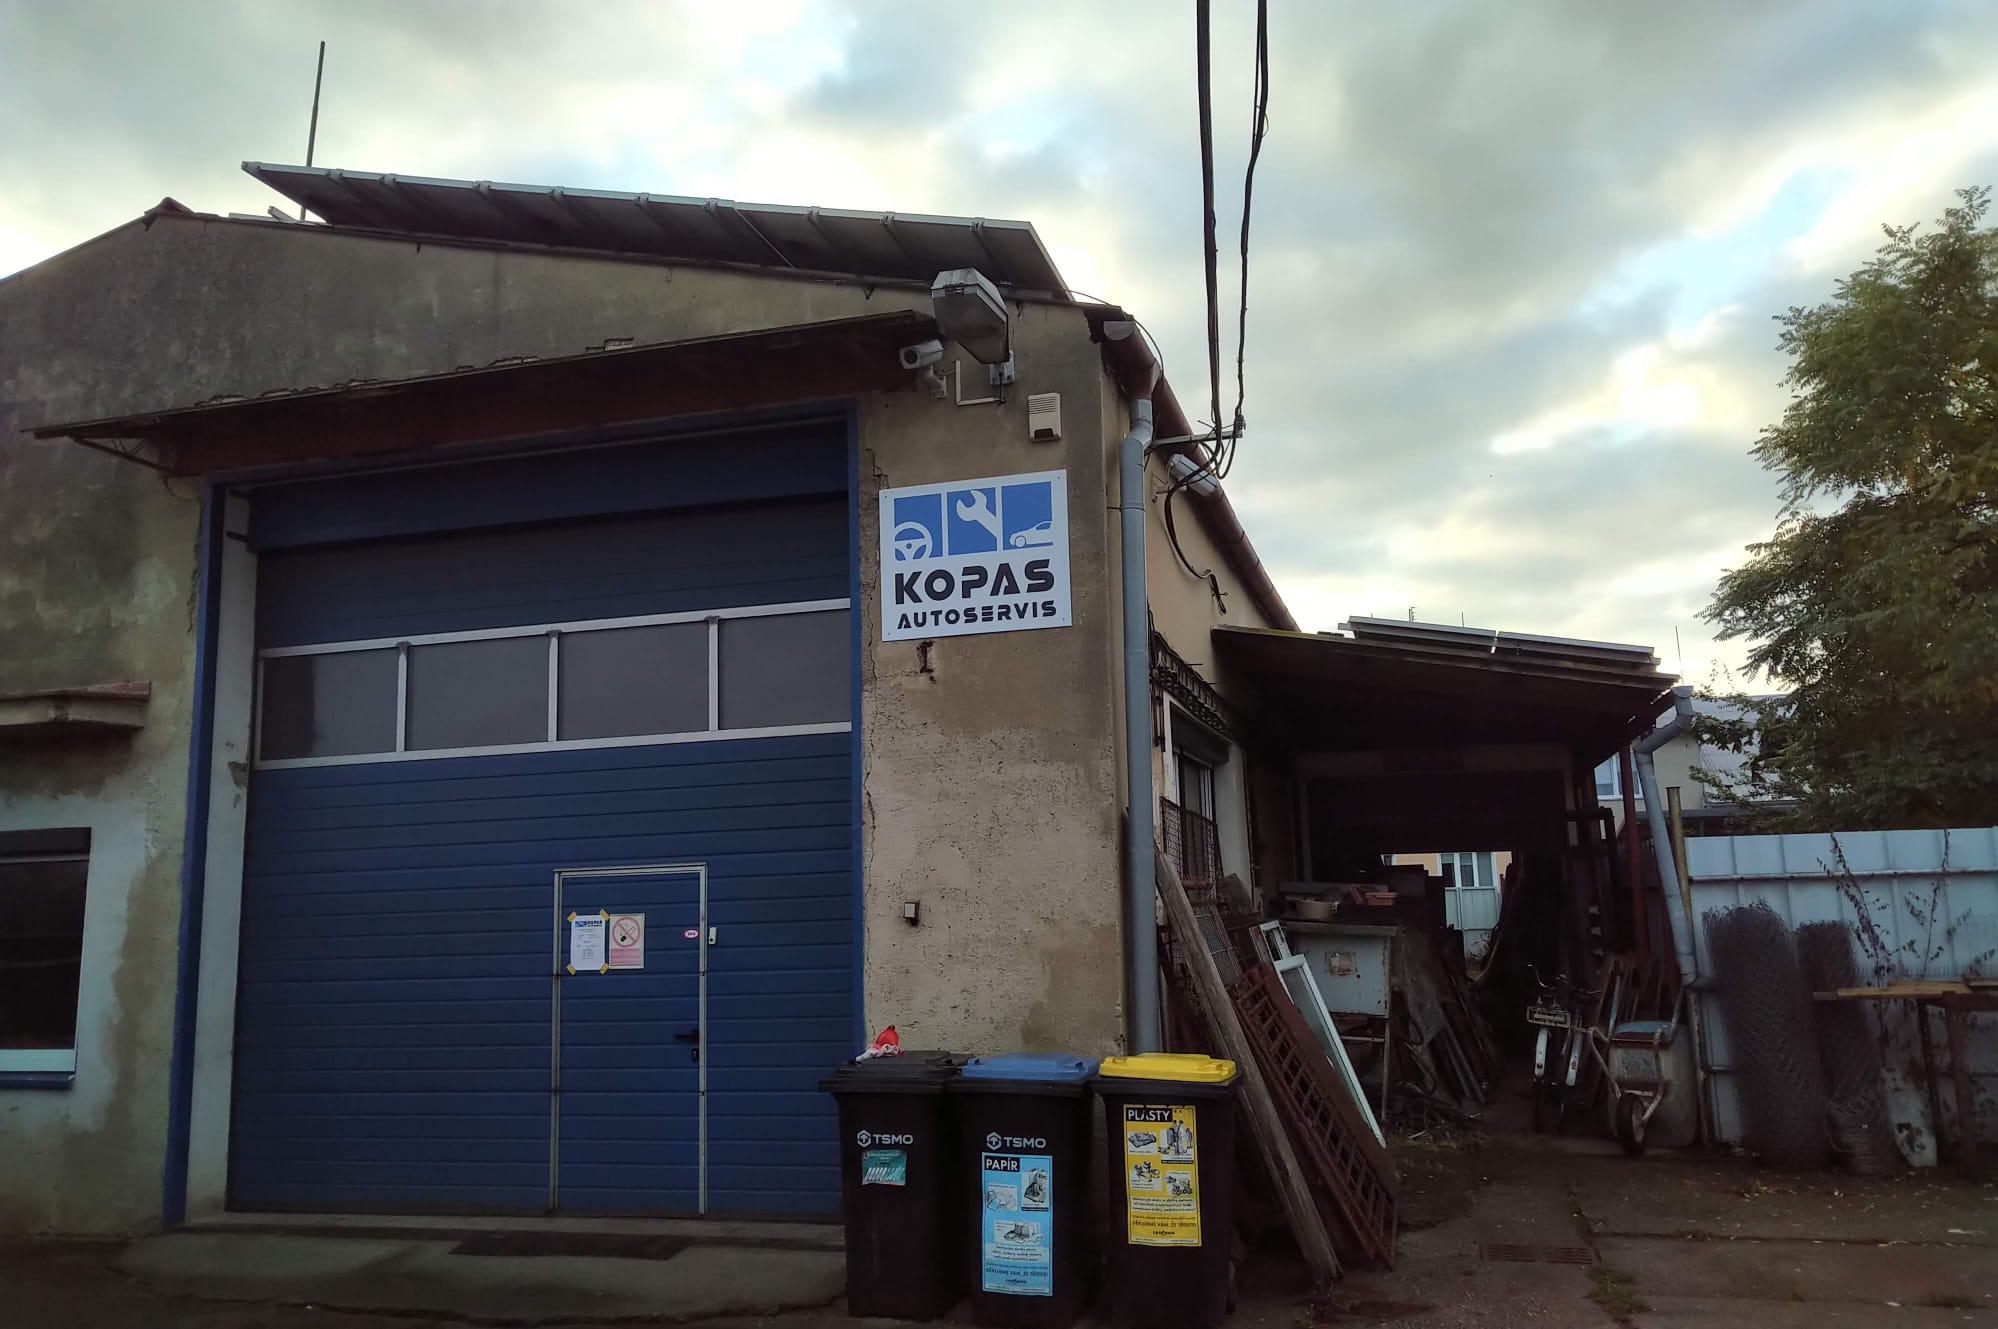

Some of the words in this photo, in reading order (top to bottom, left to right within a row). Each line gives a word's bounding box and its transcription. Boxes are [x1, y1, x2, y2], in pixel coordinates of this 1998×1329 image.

[895, 559, 1054, 604] KOPAS
[897, 600, 1056, 629] AUTOSERVIS
[1128, 1109, 1170, 1121] PLASTY
[873, 1133, 913, 1145] TSMO
[1004, 1136, 1046, 1149] TSMO
[986, 1157, 1018, 1171] PAPÍR
